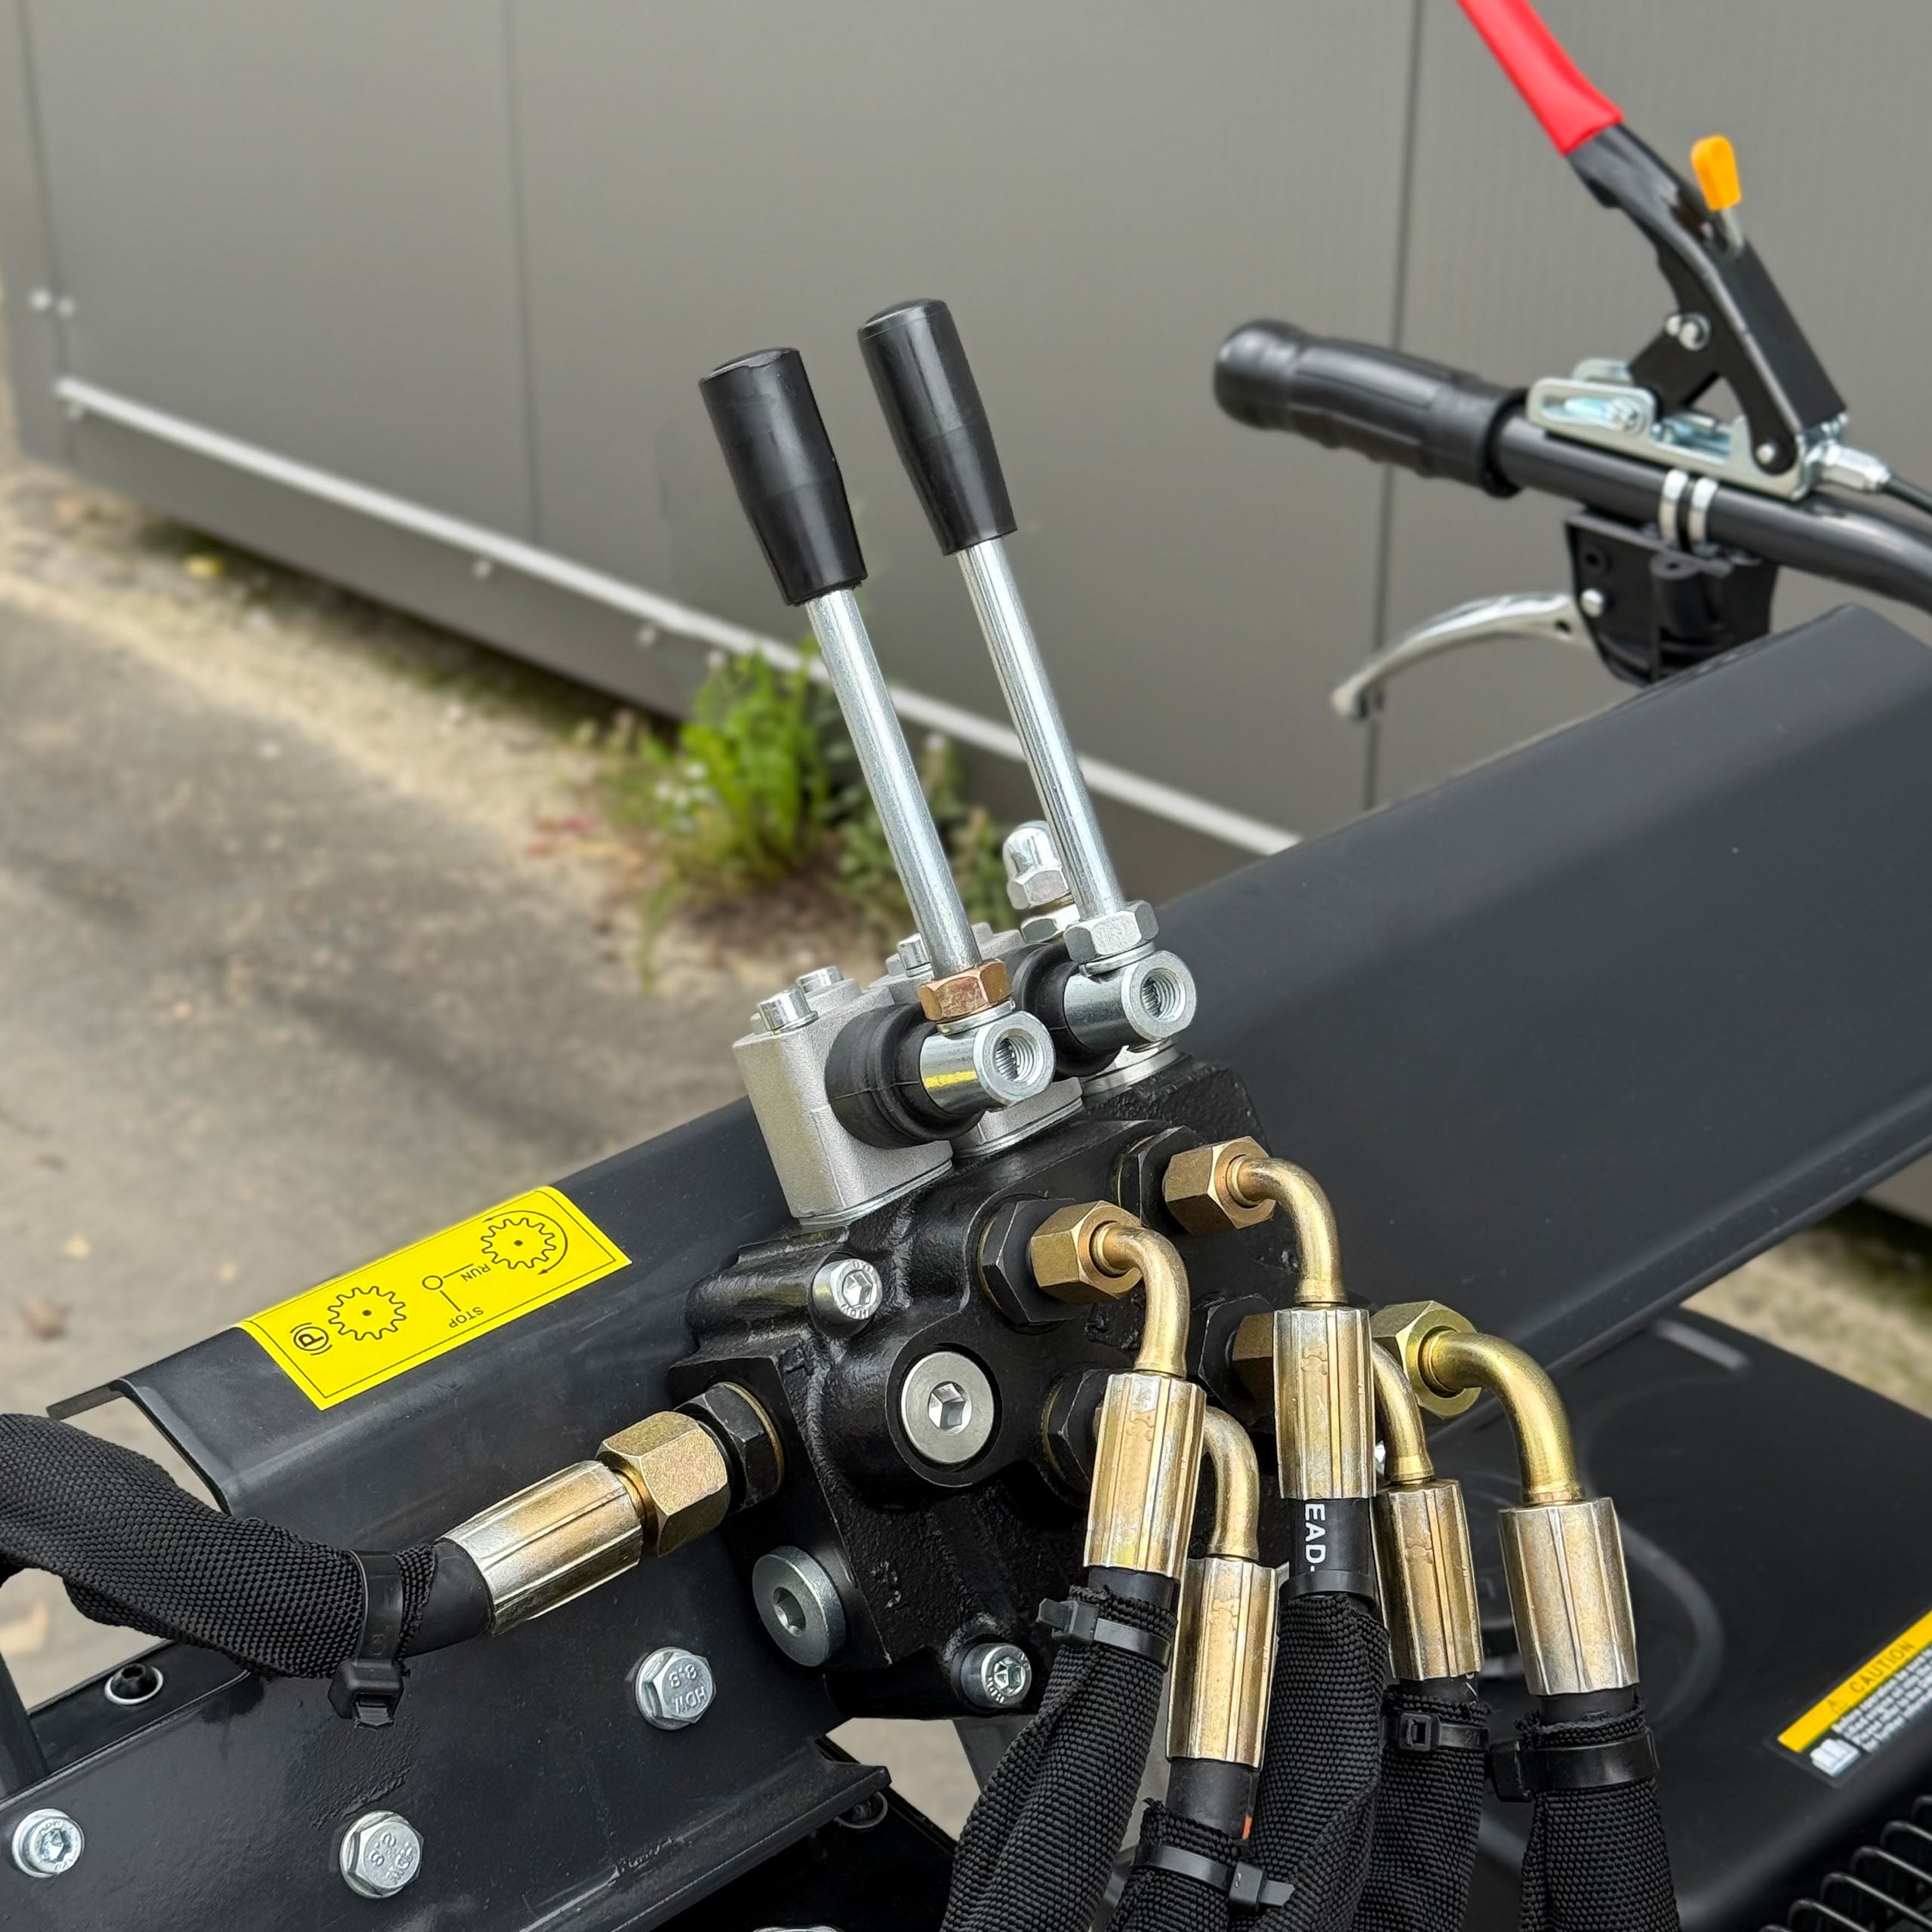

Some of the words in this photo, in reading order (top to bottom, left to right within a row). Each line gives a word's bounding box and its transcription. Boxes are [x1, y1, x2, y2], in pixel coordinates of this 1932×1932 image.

[462, 1263, 491, 1282] RUN
[448, 1306, 484, 1328] STOP
[300, 1334, 325, 1348] P
[1849, 1641, 1915, 1694] CAUTION
